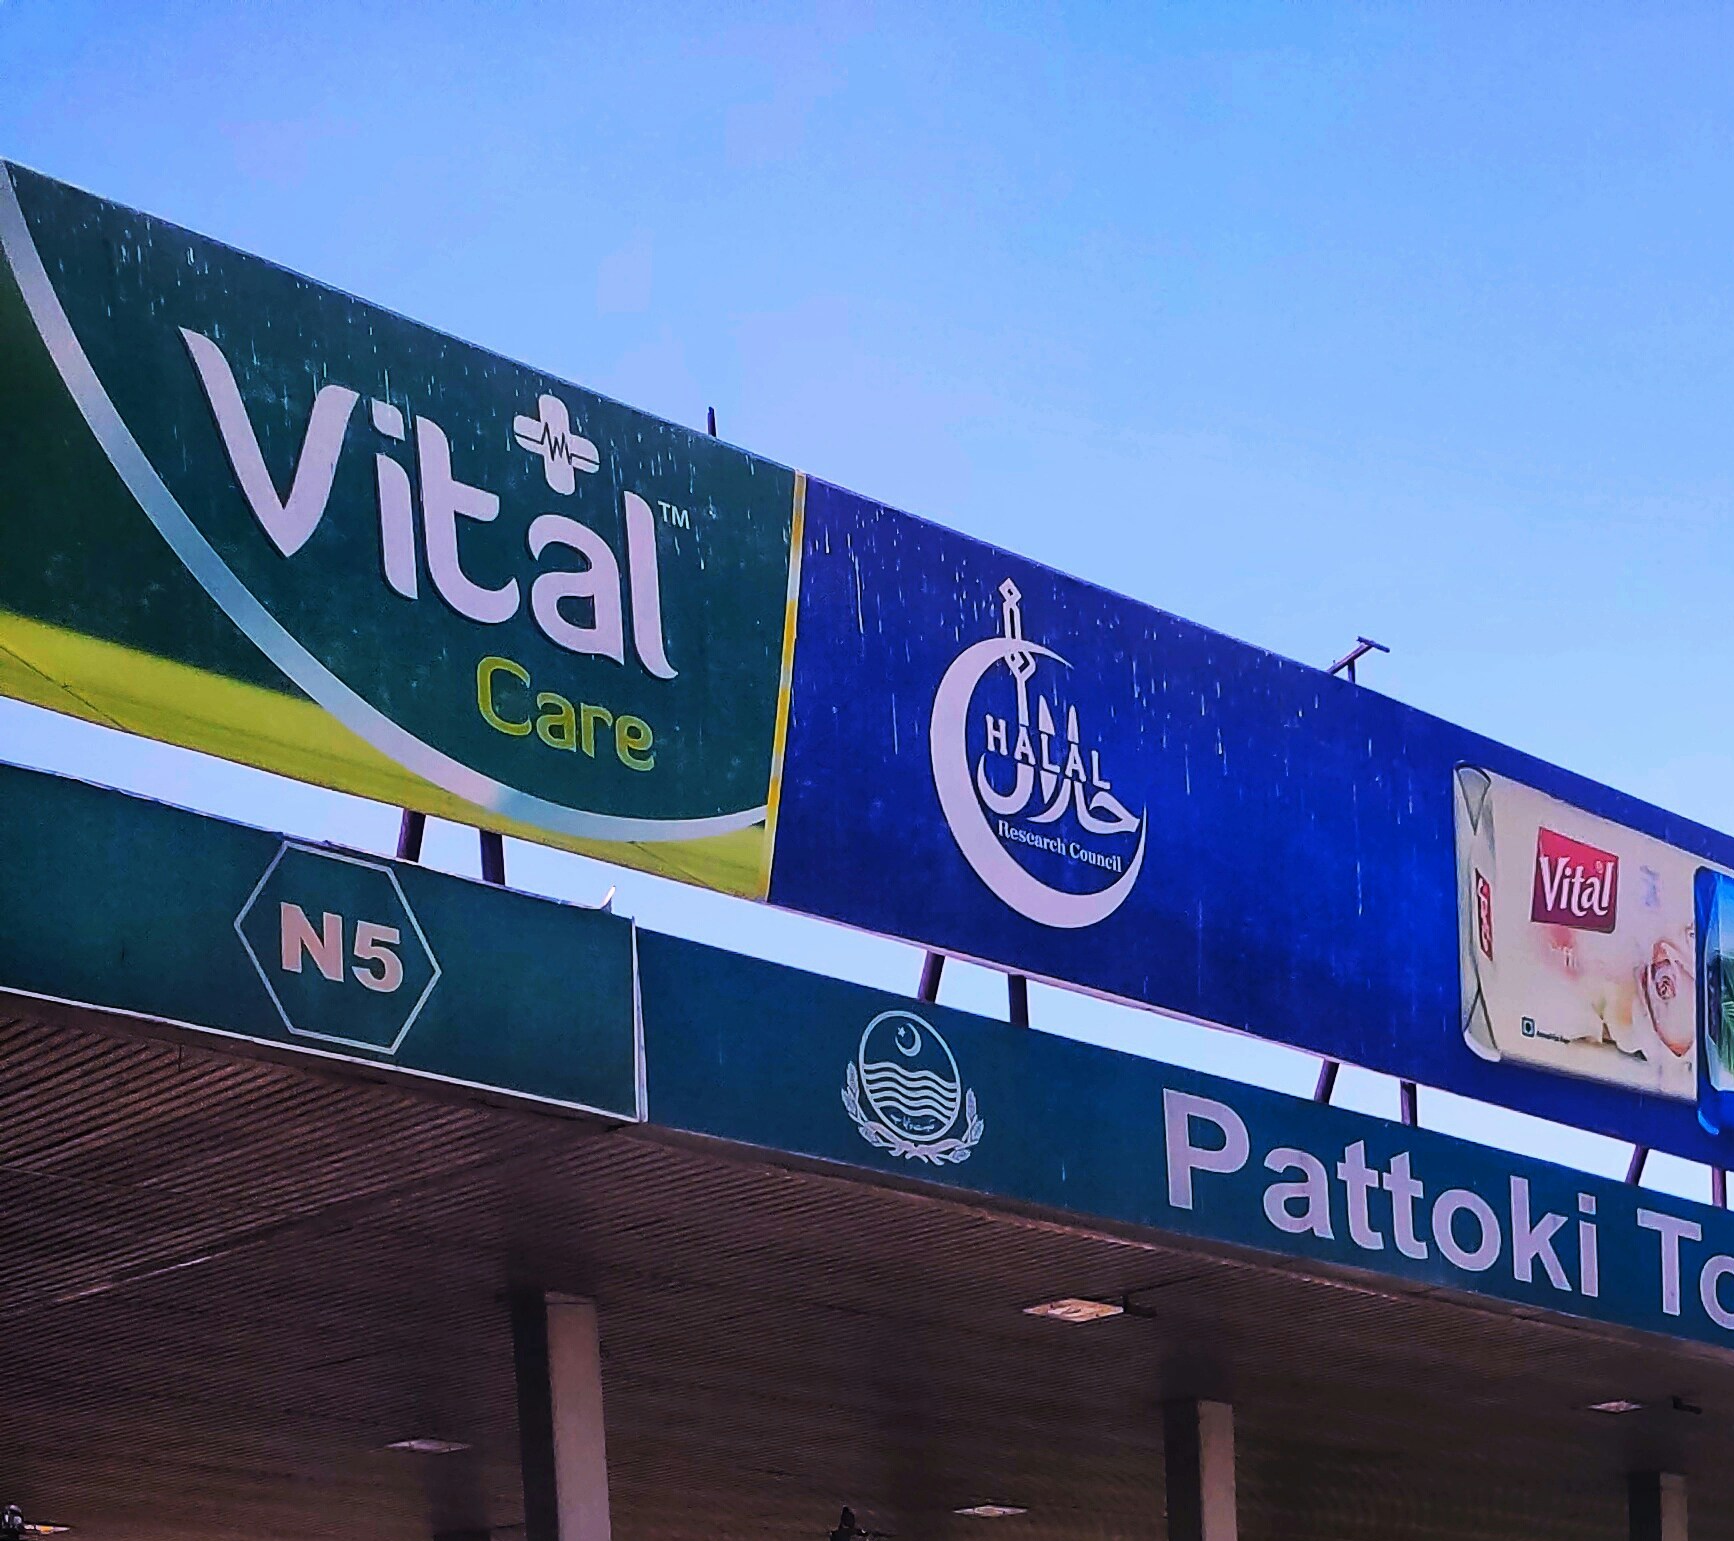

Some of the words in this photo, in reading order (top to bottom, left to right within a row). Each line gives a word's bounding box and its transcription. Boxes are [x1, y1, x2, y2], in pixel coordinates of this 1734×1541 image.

[180, 327, 678, 679] Vital
[475, 656, 655, 773] Care
[985, 713, 1110, 790] HALAL
[998, 820, 1066, 856] Research
[1070, 842, 1122, 873] Council
[1539, 854, 1616, 916] Vital
[279, 901, 404, 992] N5
[1162, 1088, 1600, 1298] Pattoki
